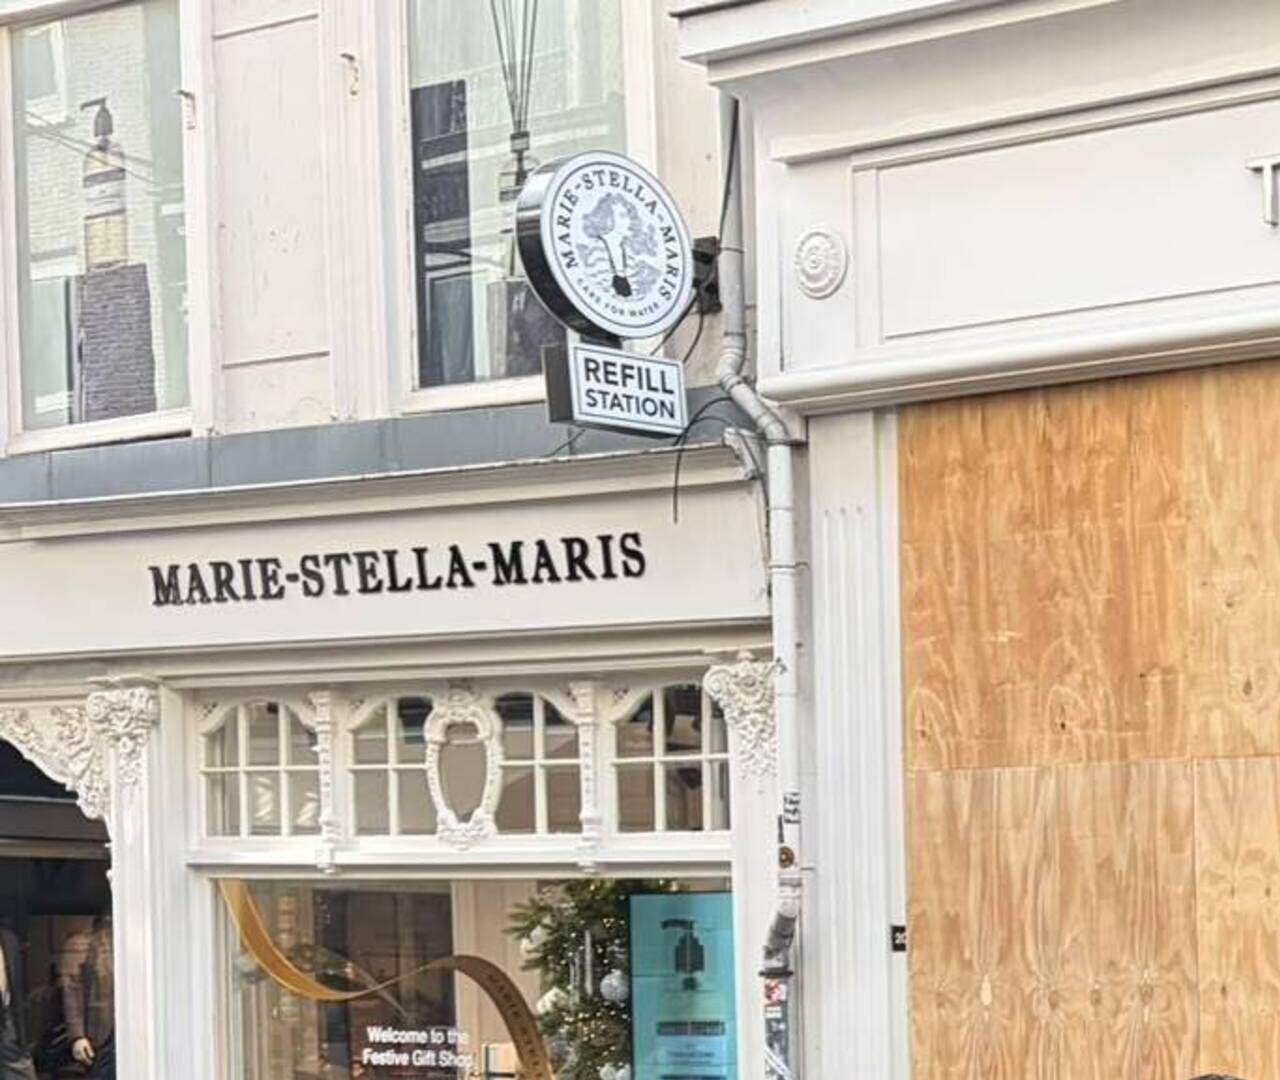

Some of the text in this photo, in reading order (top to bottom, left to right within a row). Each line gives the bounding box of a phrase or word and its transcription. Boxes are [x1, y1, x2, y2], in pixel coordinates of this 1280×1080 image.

[556, 168, 679, 301] MARIE-STELLA-MARIS
[604, 302, 625, 316] FOR
[628, 301, 660, 317] WATER
[584, 357, 675, 395] REFILL
[585, 388, 676, 419] STATION
[148, 532, 646, 607] MARIE-STELLA-MARIS
[366, 1025, 470, 1044] Welcome to the
[362, 1047, 474, 1070] Festive Gift Shop
